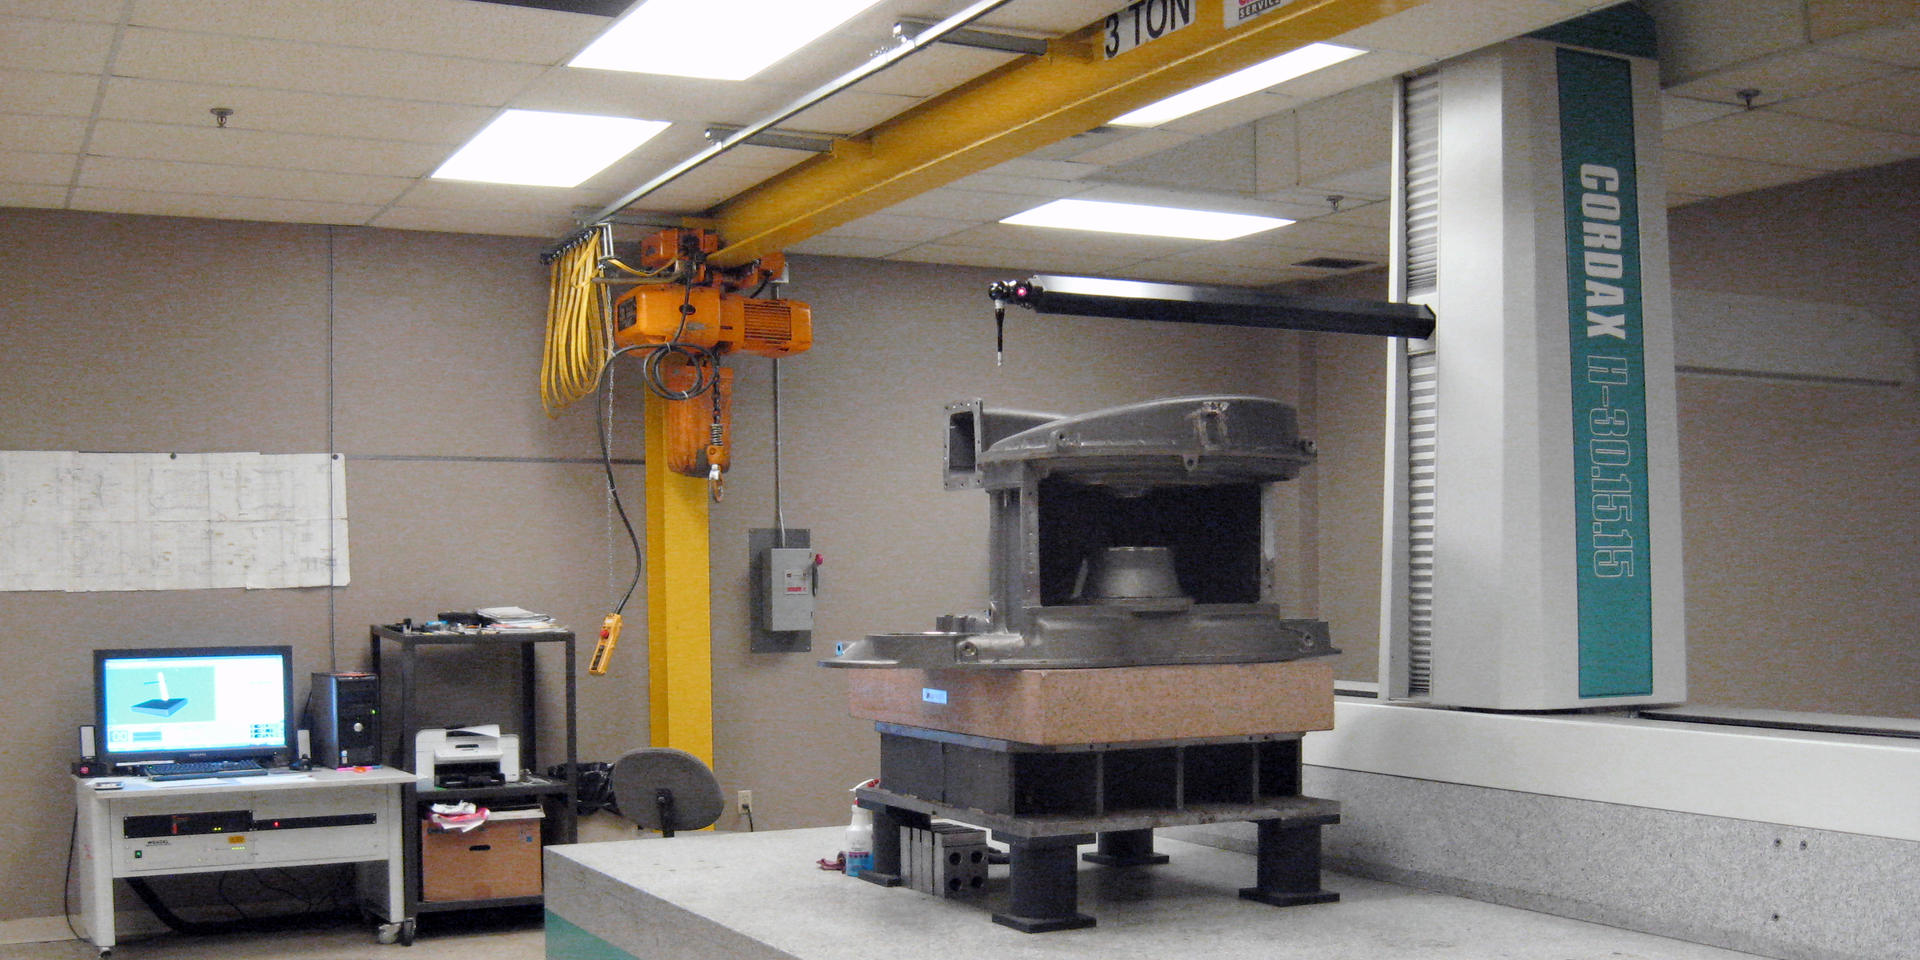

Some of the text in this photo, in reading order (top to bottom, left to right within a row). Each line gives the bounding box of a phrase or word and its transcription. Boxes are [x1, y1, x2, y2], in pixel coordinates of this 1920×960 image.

[1105, 0, 1189, 57] 3 TON
[1580, 163, 1634, 578] CORDAX H-30.15.15
